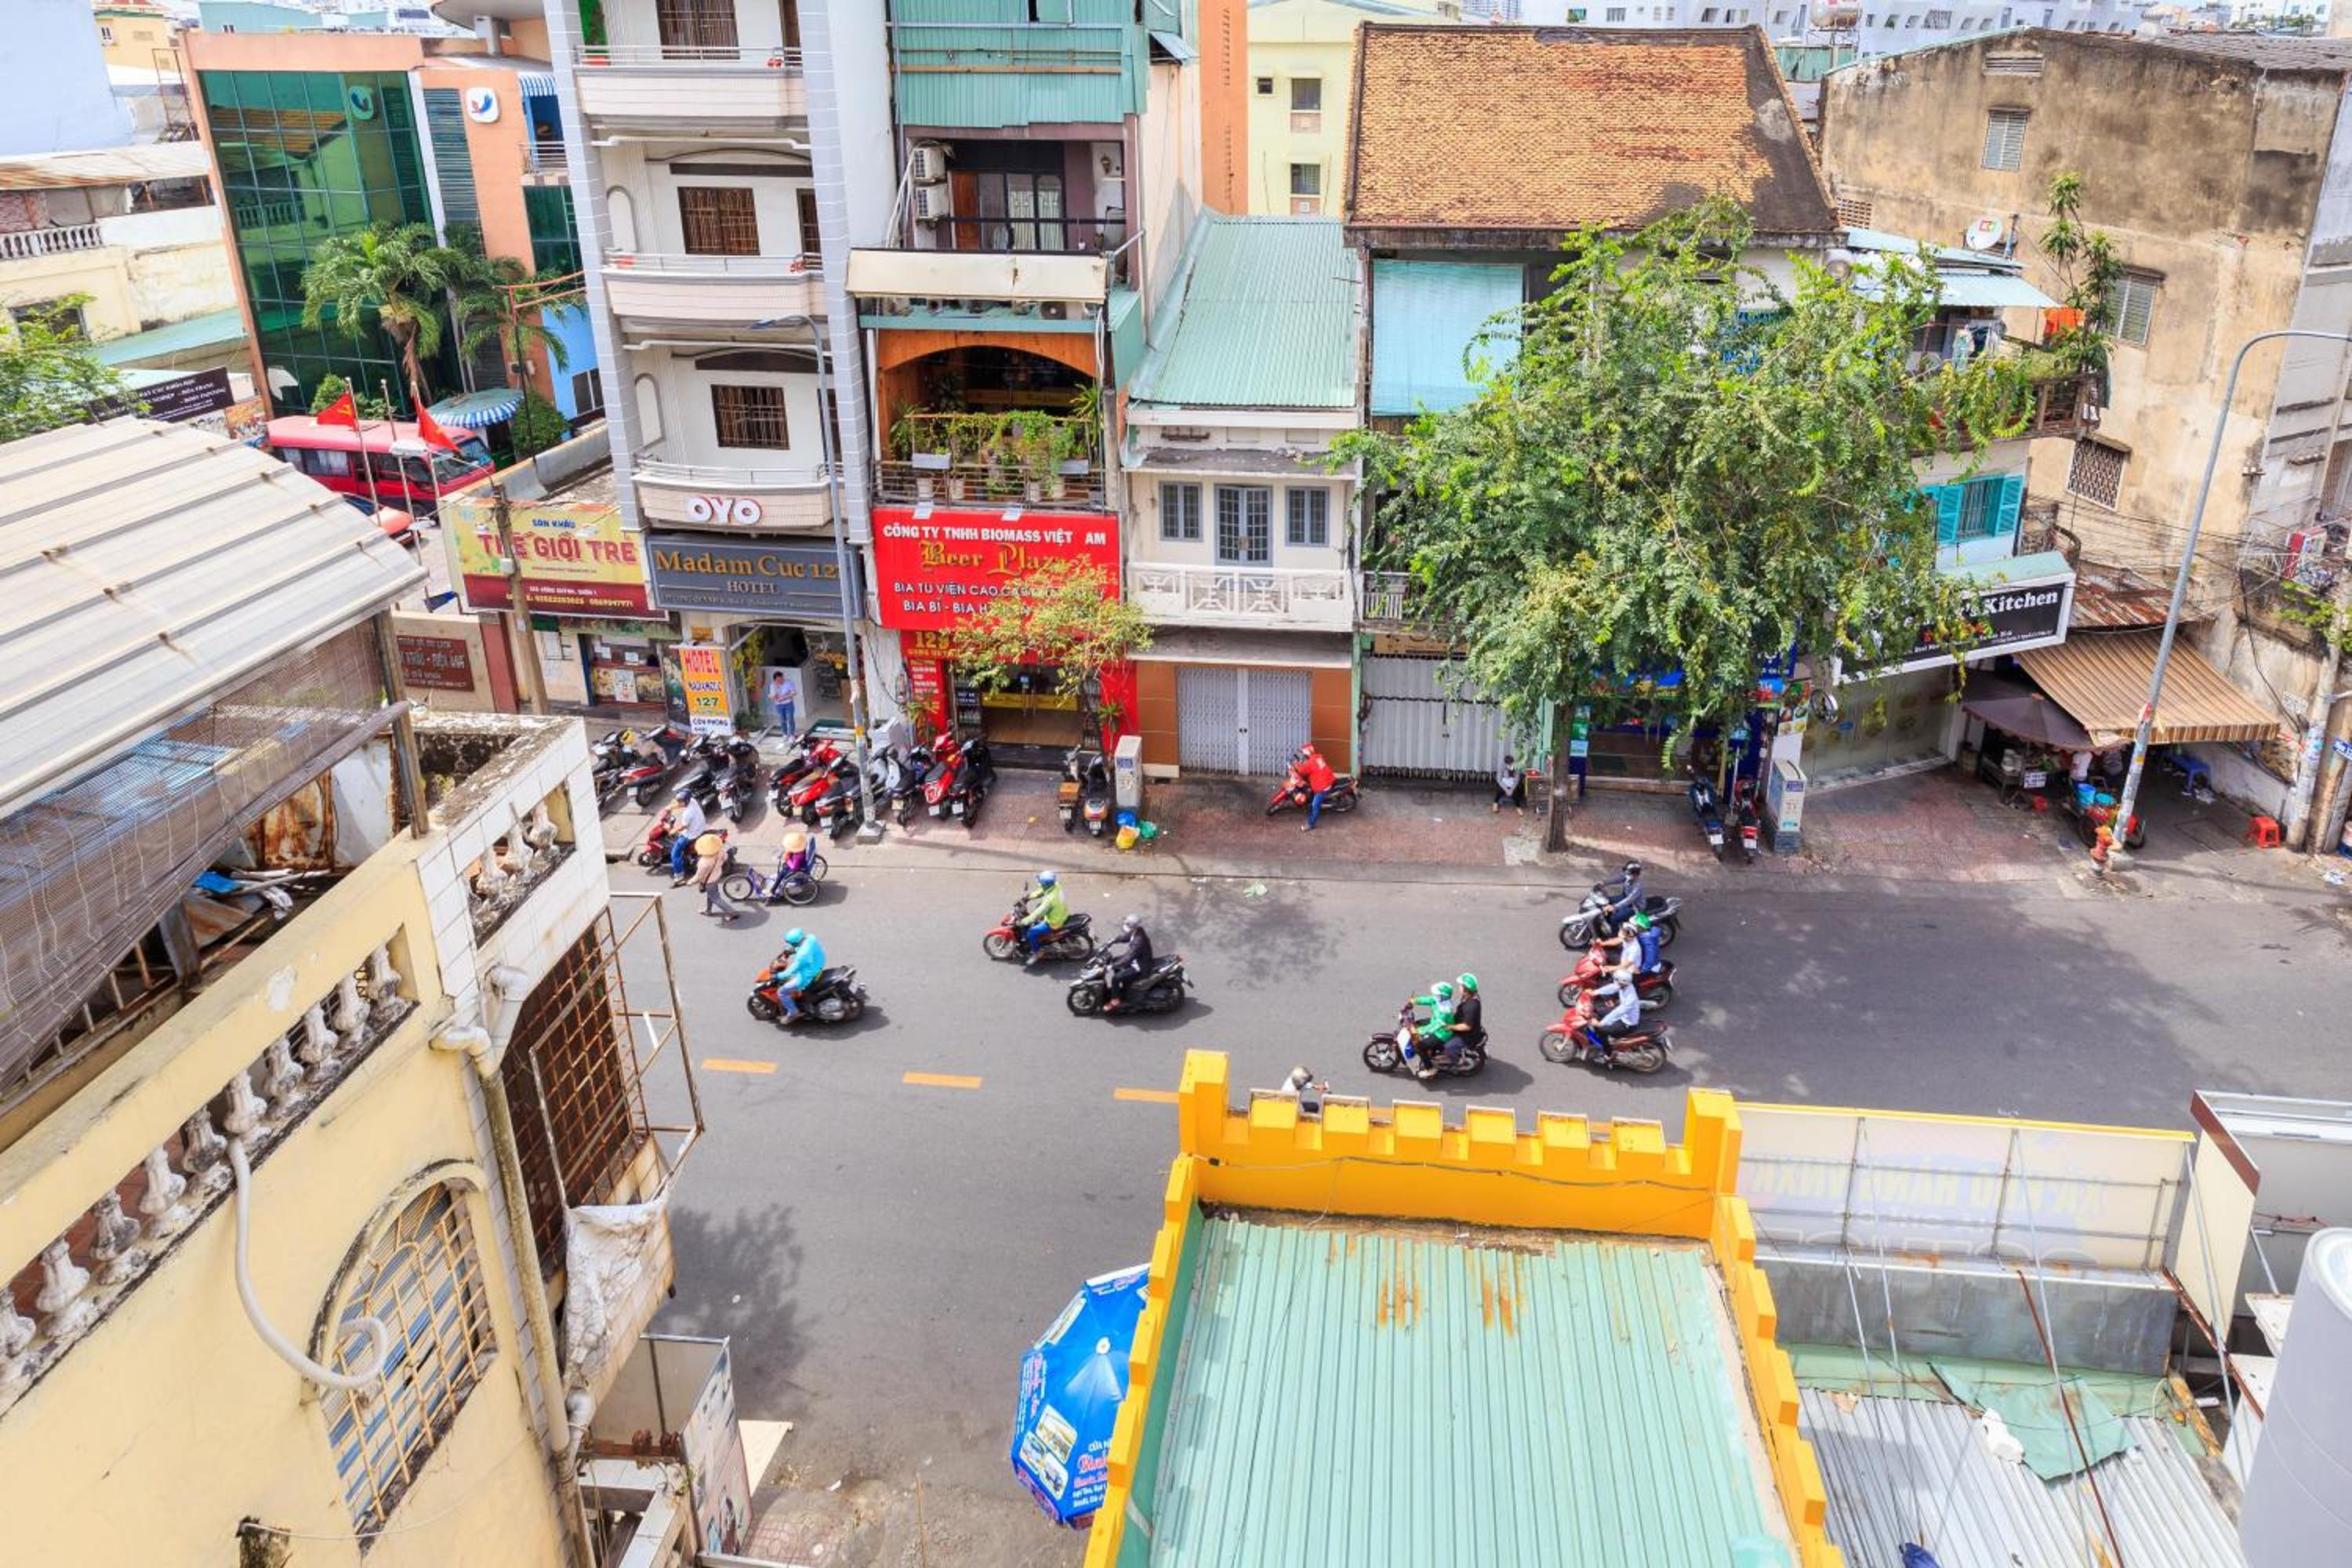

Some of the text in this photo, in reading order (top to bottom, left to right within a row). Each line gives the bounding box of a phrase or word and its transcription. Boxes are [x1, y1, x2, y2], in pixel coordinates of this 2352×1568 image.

[688, 495, 762, 524] OYO
[883, 522, 920, 538] CÔNG
[921, 526, 940, 538] TY
[943, 527, 978, 540] TNHH
[981, 528, 1041, 543] BIOMASS
[1044, 528, 1073, 546] VIỆT
[586, 531, 637, 562] TRẺ
[918, 540, 983, 569] Beer
[655, 550, 753, 576] Madam
[757, 554, 804, 578] Cuc
[727, 580, 778, 593] HOTEL
[894, 582, 914, 593] BIA
[937, 582, 966, 598] VIỆN
[969, 585, 998, 596] CAO
[903, 600, 926, 612] BIA
[953, 602, 975, 614] BIA
[1984, 592, 2058, 615] Kitchen
[696, 696, 719, 706] 127
